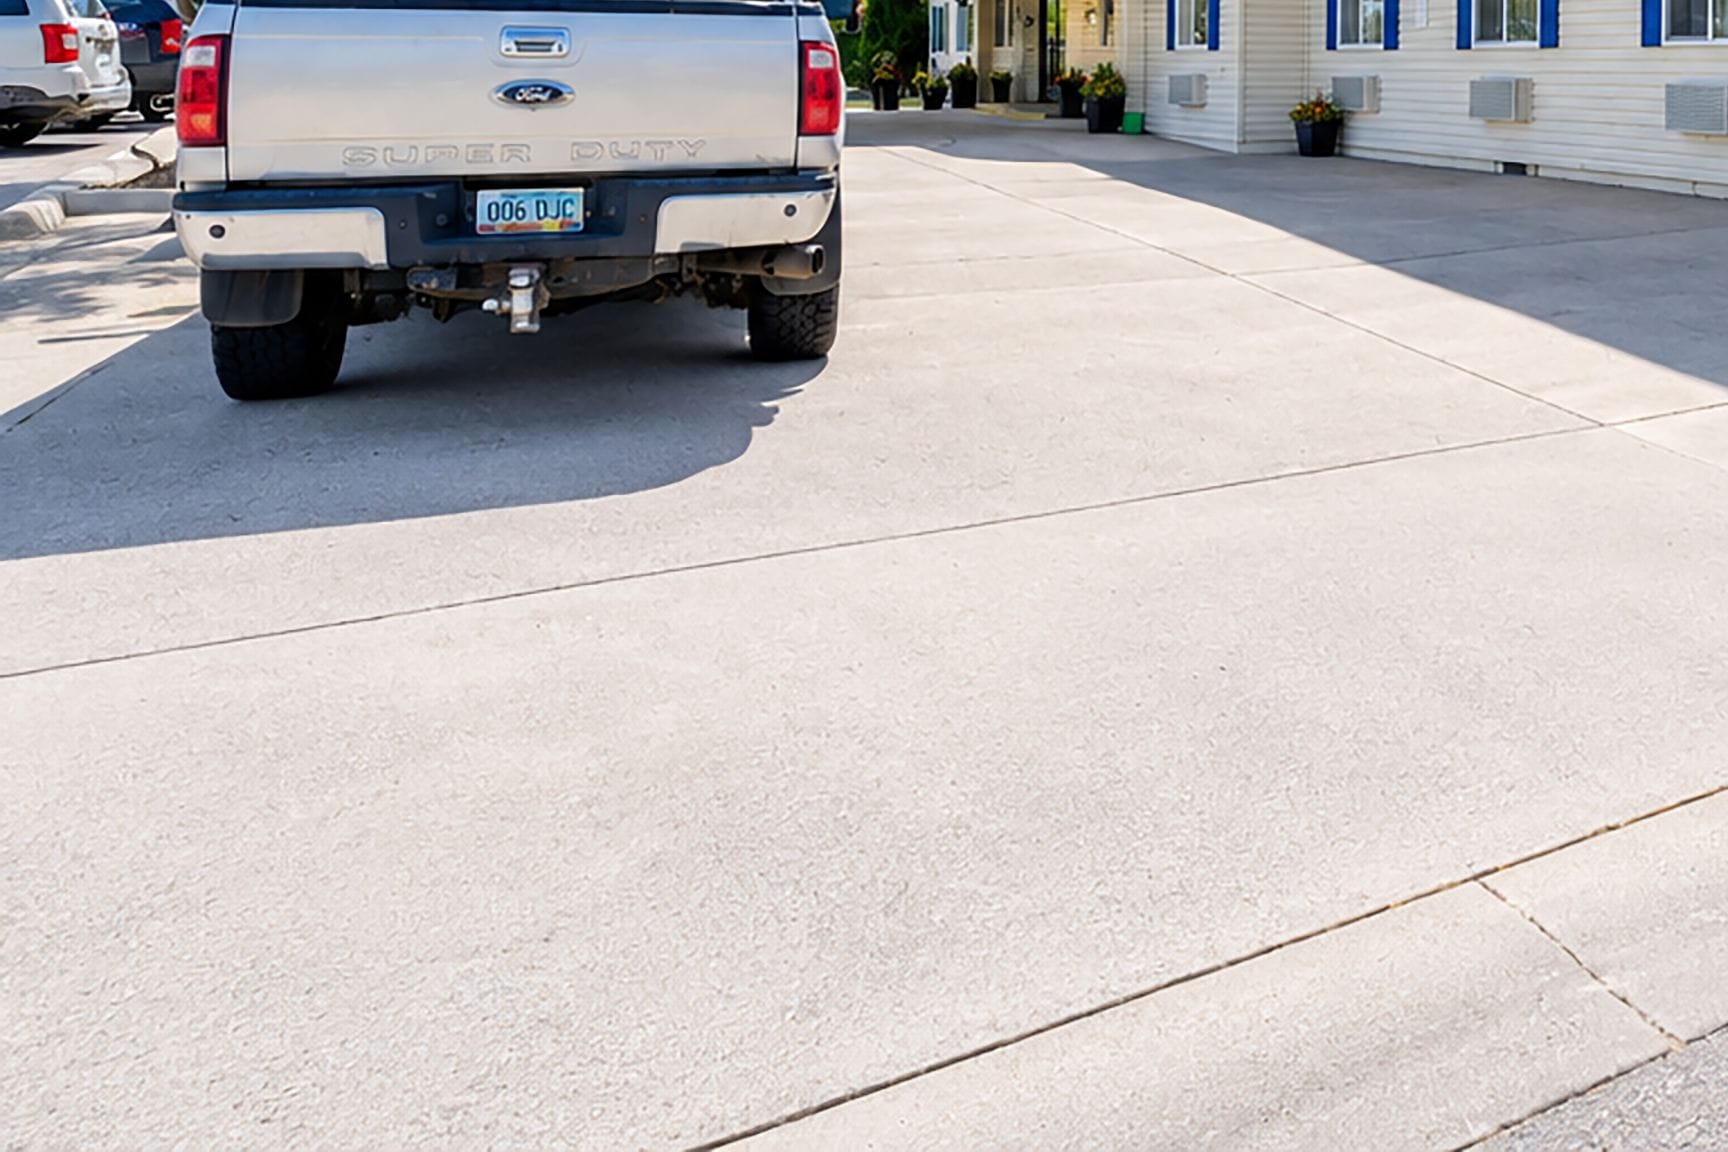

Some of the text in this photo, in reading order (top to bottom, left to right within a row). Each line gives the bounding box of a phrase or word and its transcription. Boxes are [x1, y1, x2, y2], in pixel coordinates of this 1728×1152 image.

[515, 86, 553, 102] Ford
[342, 138, 706, 166] SUPER DUTY
